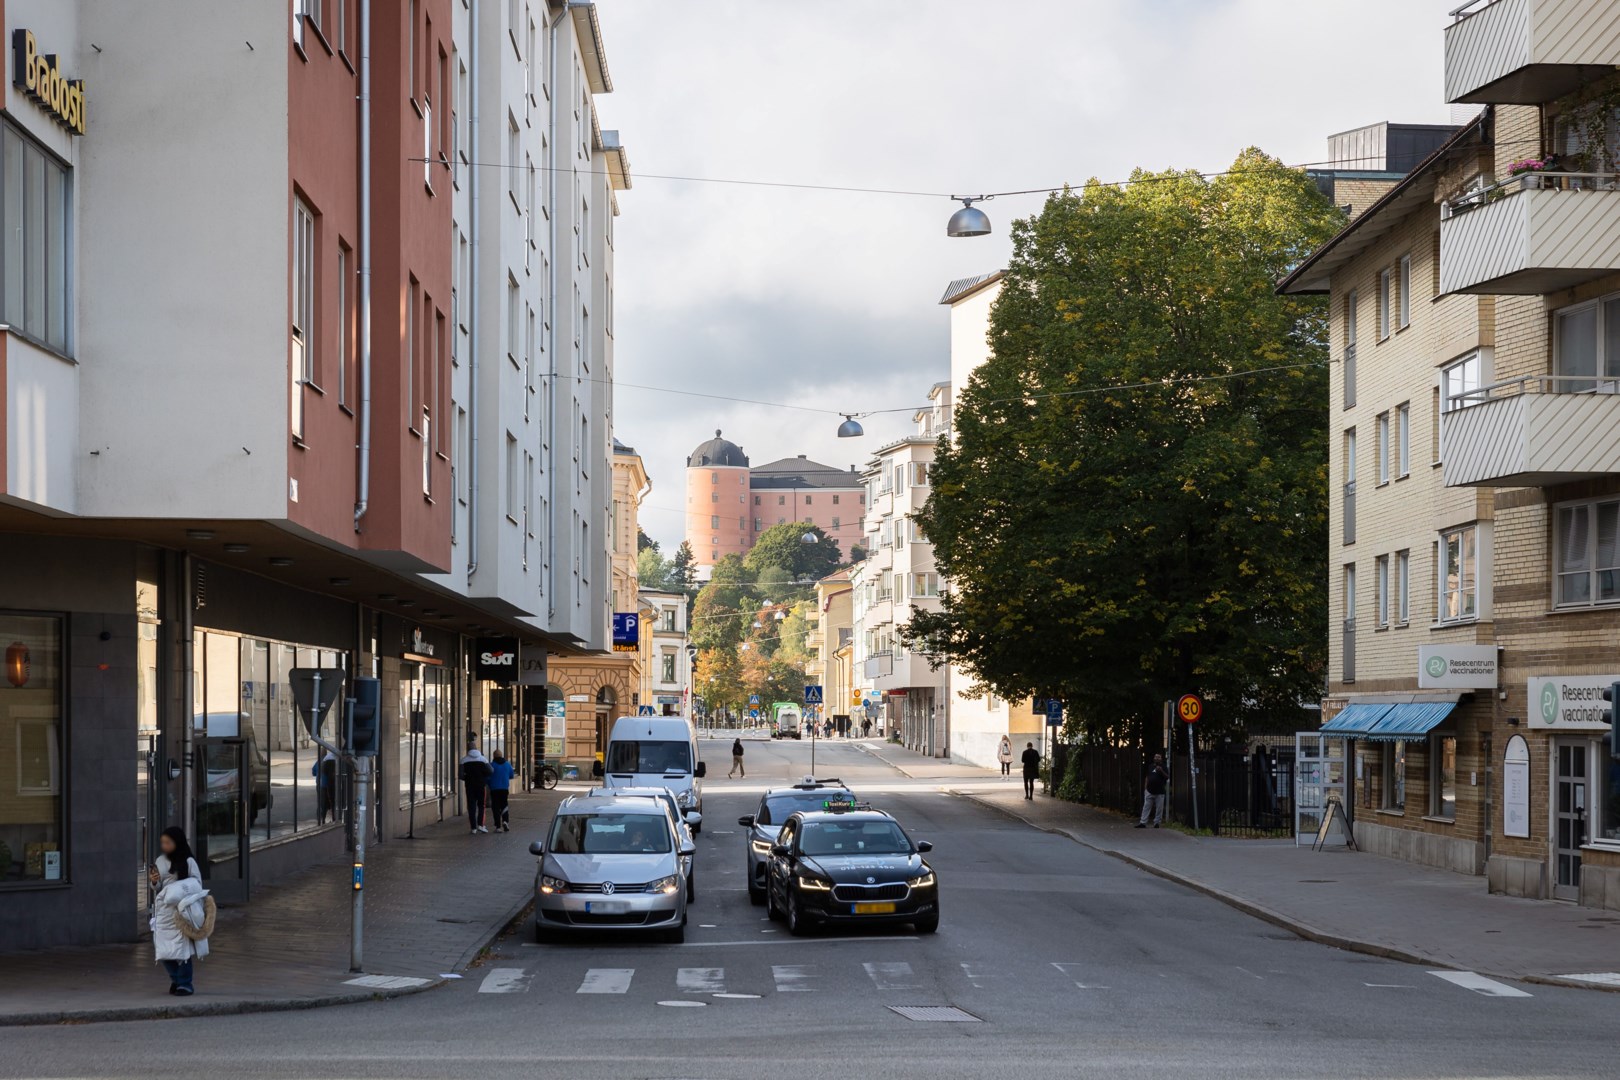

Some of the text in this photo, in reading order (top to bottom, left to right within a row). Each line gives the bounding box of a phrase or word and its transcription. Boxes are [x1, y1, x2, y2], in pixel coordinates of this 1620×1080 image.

[25, 29, 86, 136] Bradosti
[626, 619, 636, 632] P
[1449, 659, 1494, 667] Resecentrum
[1449, 667, 1494, 675] vaccinationer
[1561, 684, 1605, 701] Resecentr
[1182, 701, 1199, 716] 30
[1561, 704, 1604, 722] vaccinatio
